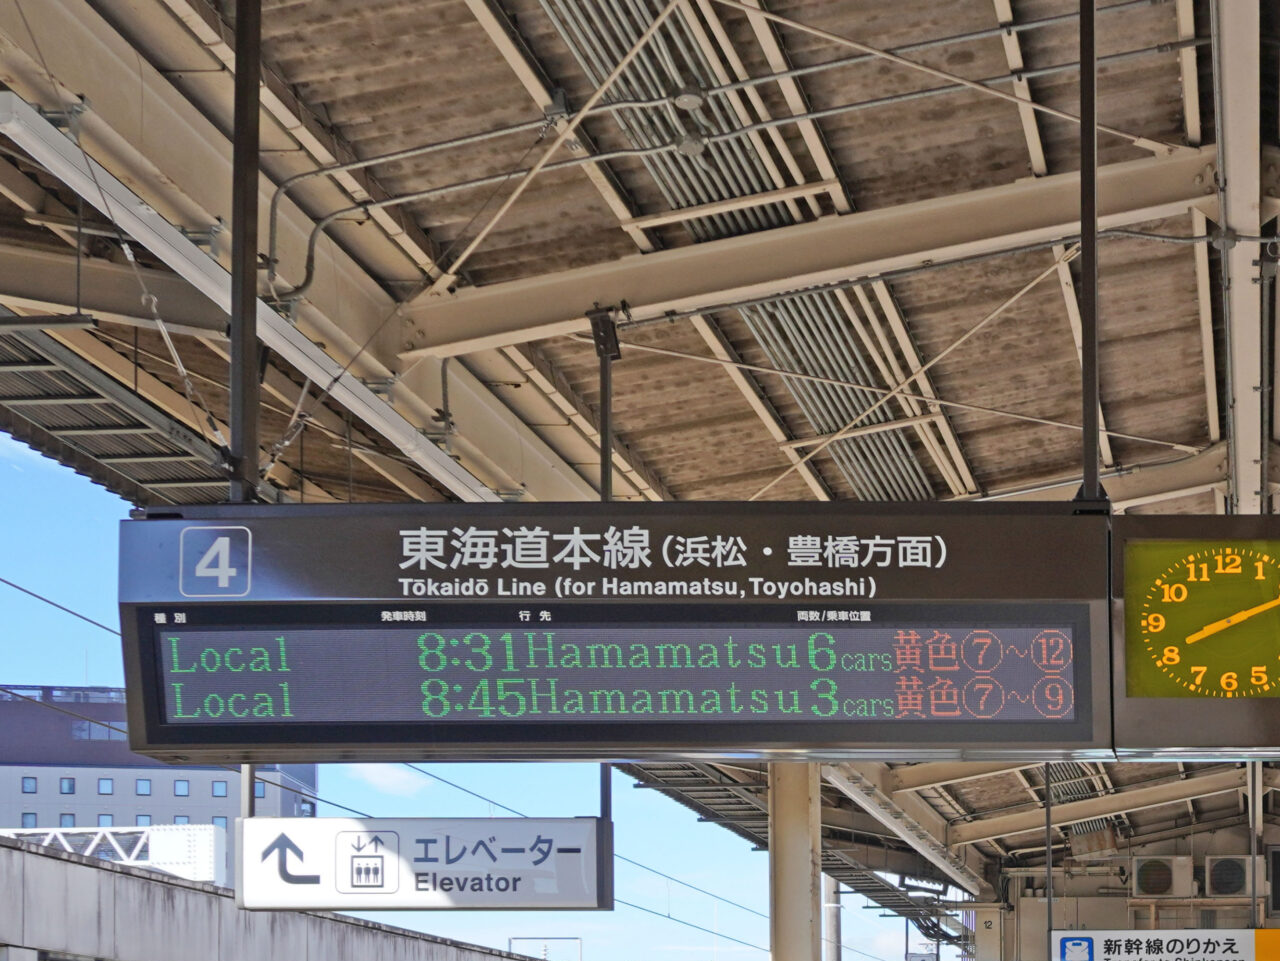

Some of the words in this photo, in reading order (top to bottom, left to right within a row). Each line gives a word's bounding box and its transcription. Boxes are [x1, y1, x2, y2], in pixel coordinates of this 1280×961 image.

[195, 537, 236, 587] 4
[1214, 555, 1242, 573] 12
[1254, 561, 1266, 580] 1
[1186, 563, 1210, 581] 11
[398, 578, 489, 596] Tōkaidō
[497, 578, 546, 596] Line
[554, 576, 596, 598] (for
[1161, 583, 1188, 602] 10
[1147, 613, 1166, 632] 9
[168, 636, 292, 672] Local
[417, 632, 520, 672] 8:31
[524, 632, 801, 668] Hamamatsu
[1162, 646, 1181, 665] 8
[1190, 666, 1207, 685] 7
[1220, 672, 1238, 691] 6
[1250, 665, 1268, 685] 5
[171, 681, 294, 718] Local
[420, 679, 526, 718] 8:45
[527, 678, 803, 714] Hamamatsu
[413, 834, 582, 866] エレベーター
[414, 872, 522, 892] Elevator
[984, 920, 993, 930] 12
[1103, 938, 1239, 956] 新幹線のりかえ
